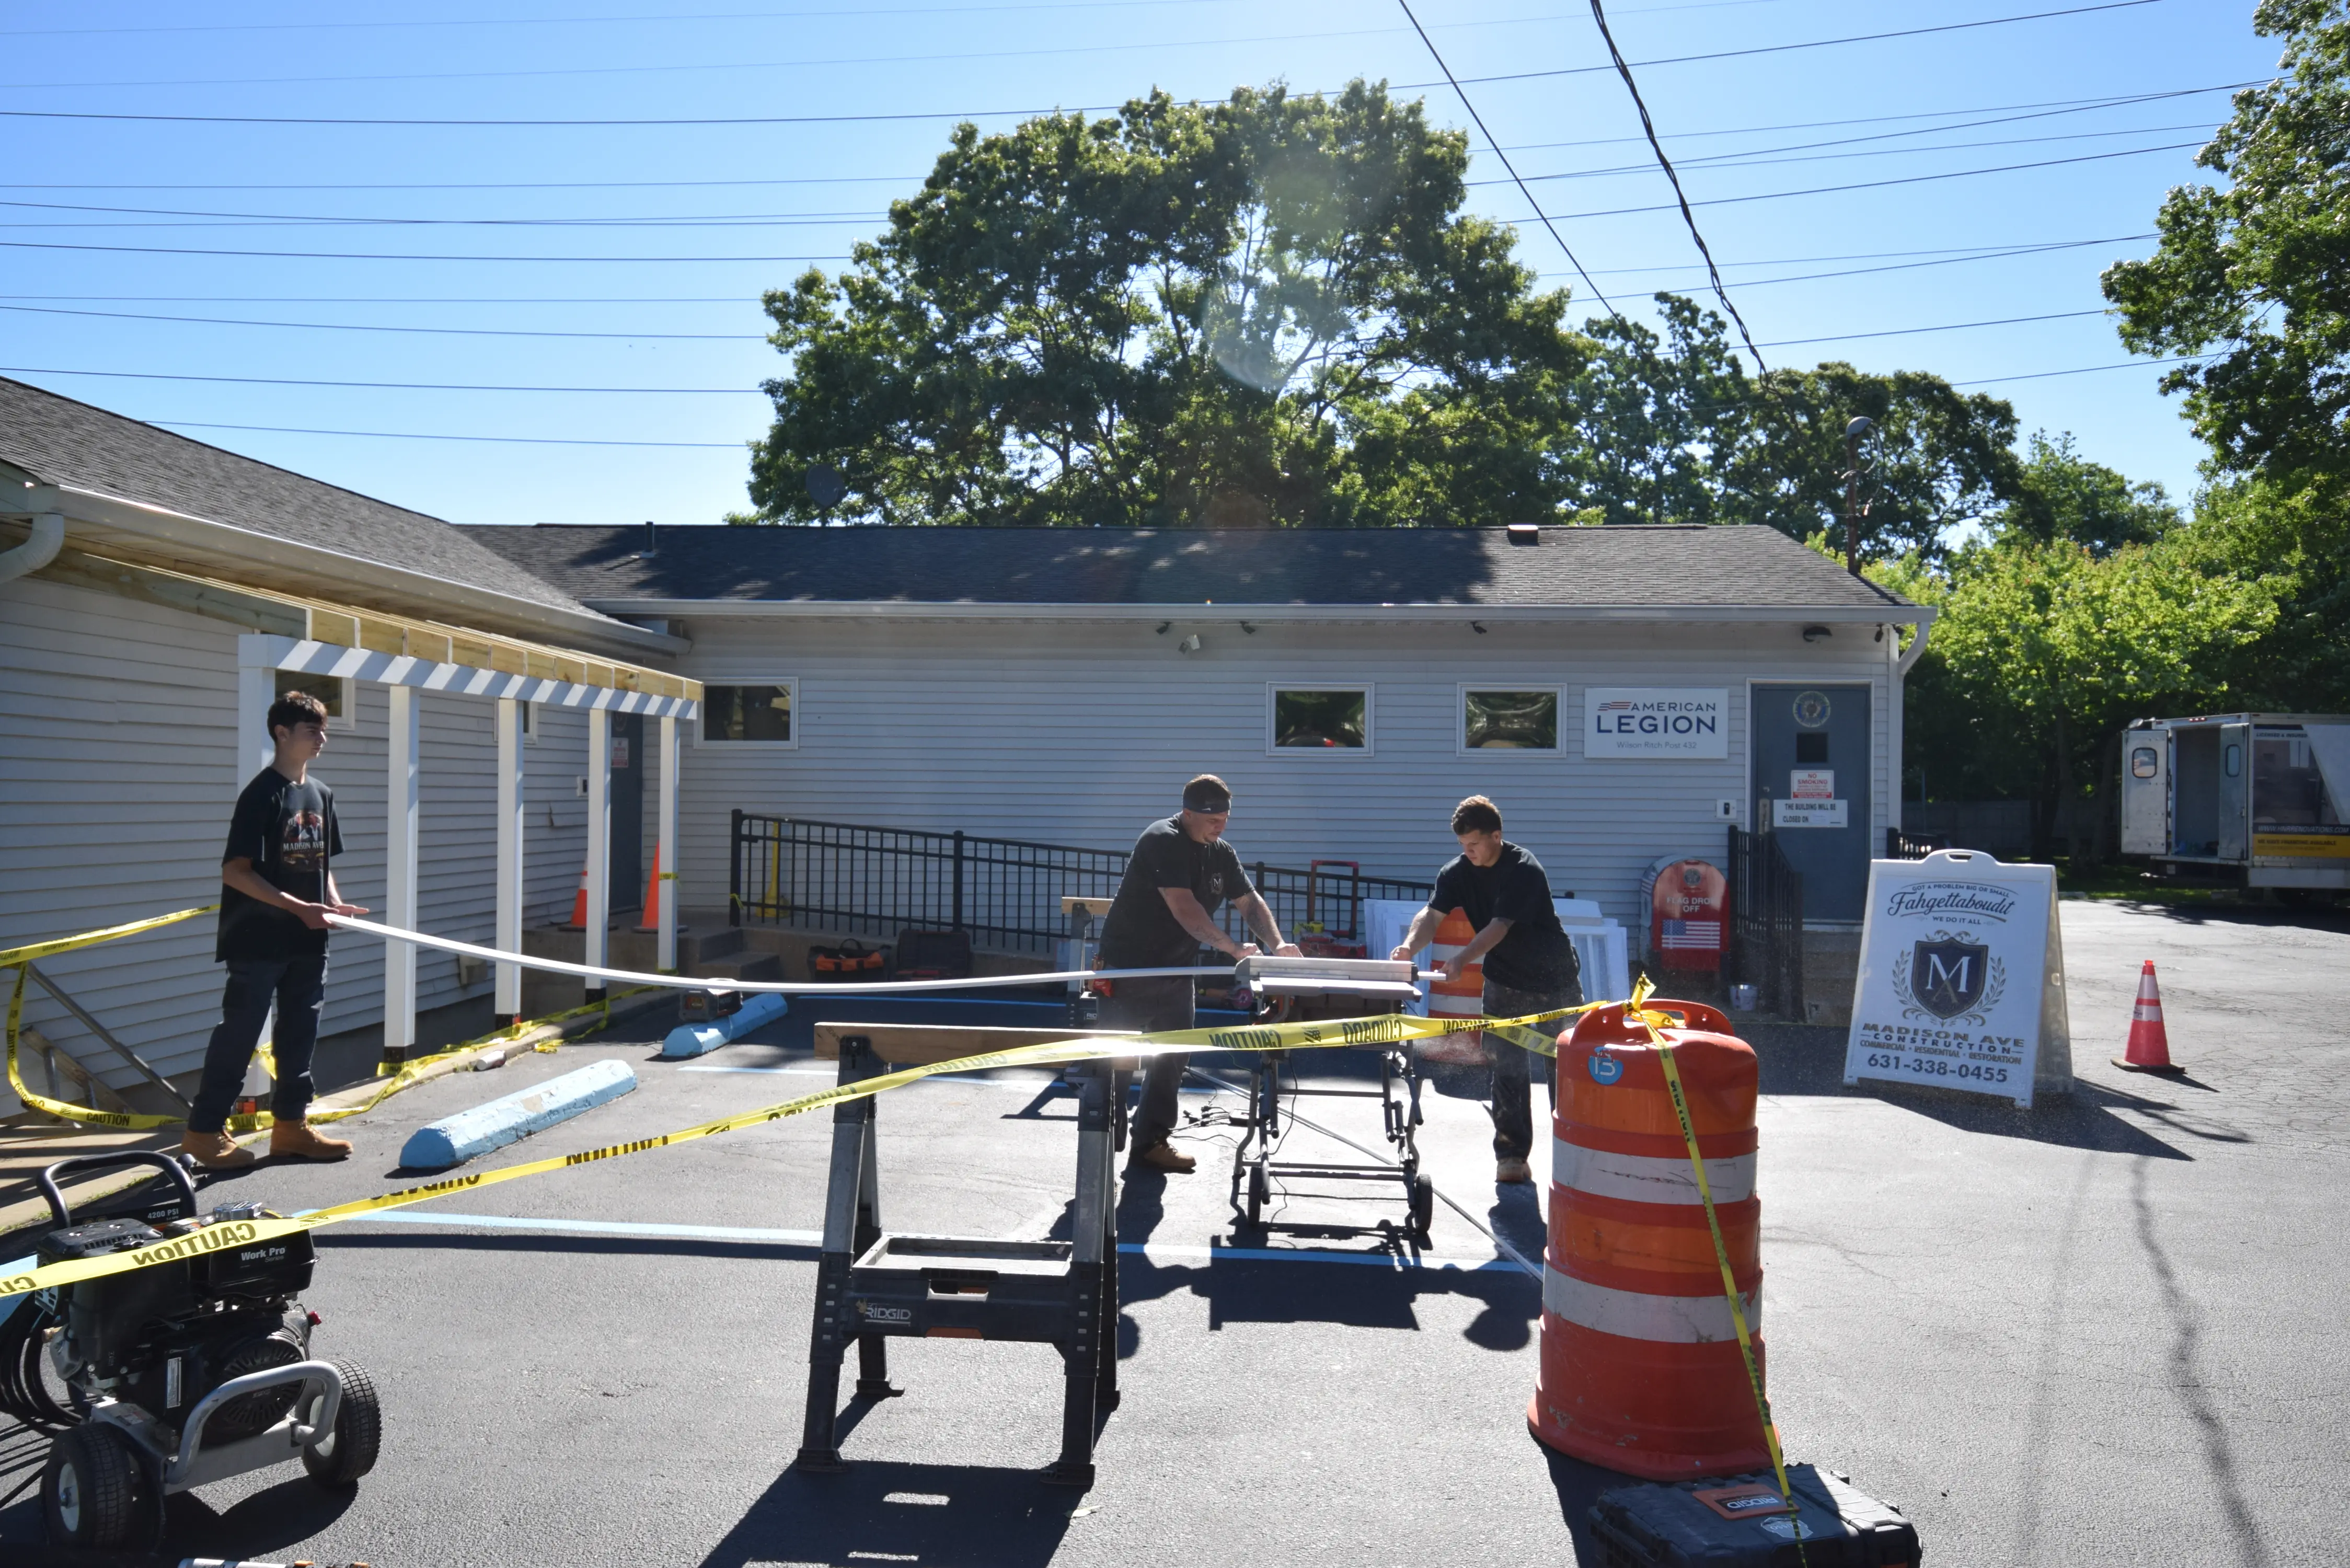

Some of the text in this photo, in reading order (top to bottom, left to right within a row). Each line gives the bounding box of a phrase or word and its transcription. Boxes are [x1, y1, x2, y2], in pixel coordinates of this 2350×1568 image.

[1631, 702, 1716, 712] AMERICAN
[1597, 715, 1715, 734] LEGION
[1989, 889, 2010, 898] SMALL
[1862, 1023, 2025, 1047] MADISON AVE
[1873, 1033, 2011, 1054] CONSTRUCTION
[1860, 1040, 2022, 1065] COMMERCIAL RESIDENTIAL RESTORATION
[1868, 1054, 2008, 1083] 631-338-0455
[86, 1112, 130, 1126] CAUTION
[147, 1210, 166, 1219] 4200
[240, 1247, 285, 1261] Work Pro
[865, 1307, 912, 1320] RIDGID
[1726, 1496, 1779, 1509] RIDGID
